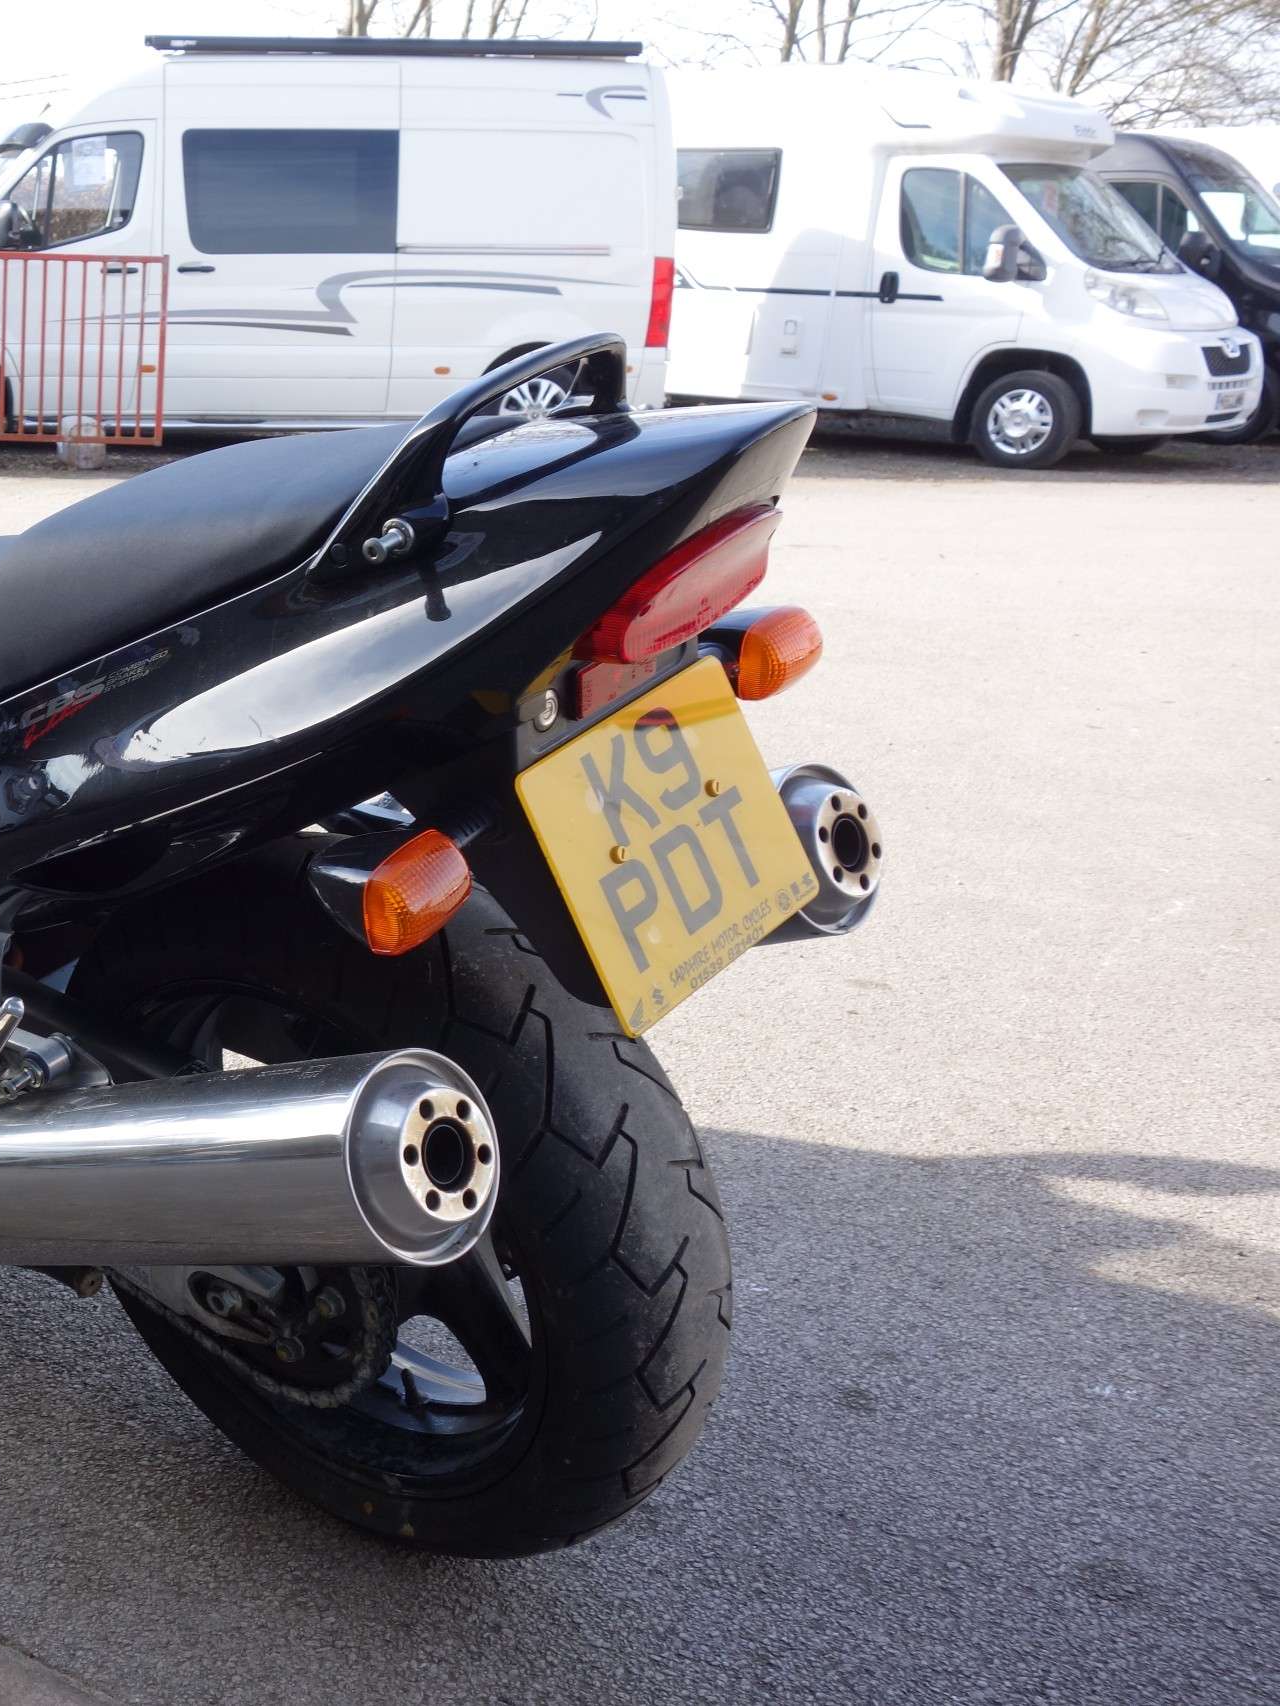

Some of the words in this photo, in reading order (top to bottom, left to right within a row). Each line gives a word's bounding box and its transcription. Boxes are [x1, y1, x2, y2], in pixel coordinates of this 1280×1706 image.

[20, 675, 107, 730] CBS
[579, 706, 702, 847] K9
[598, 785, 761, 974] PDT
[711, 922, 742, 955] MOTOR
[742, 898, 772, 930] CYCLES
